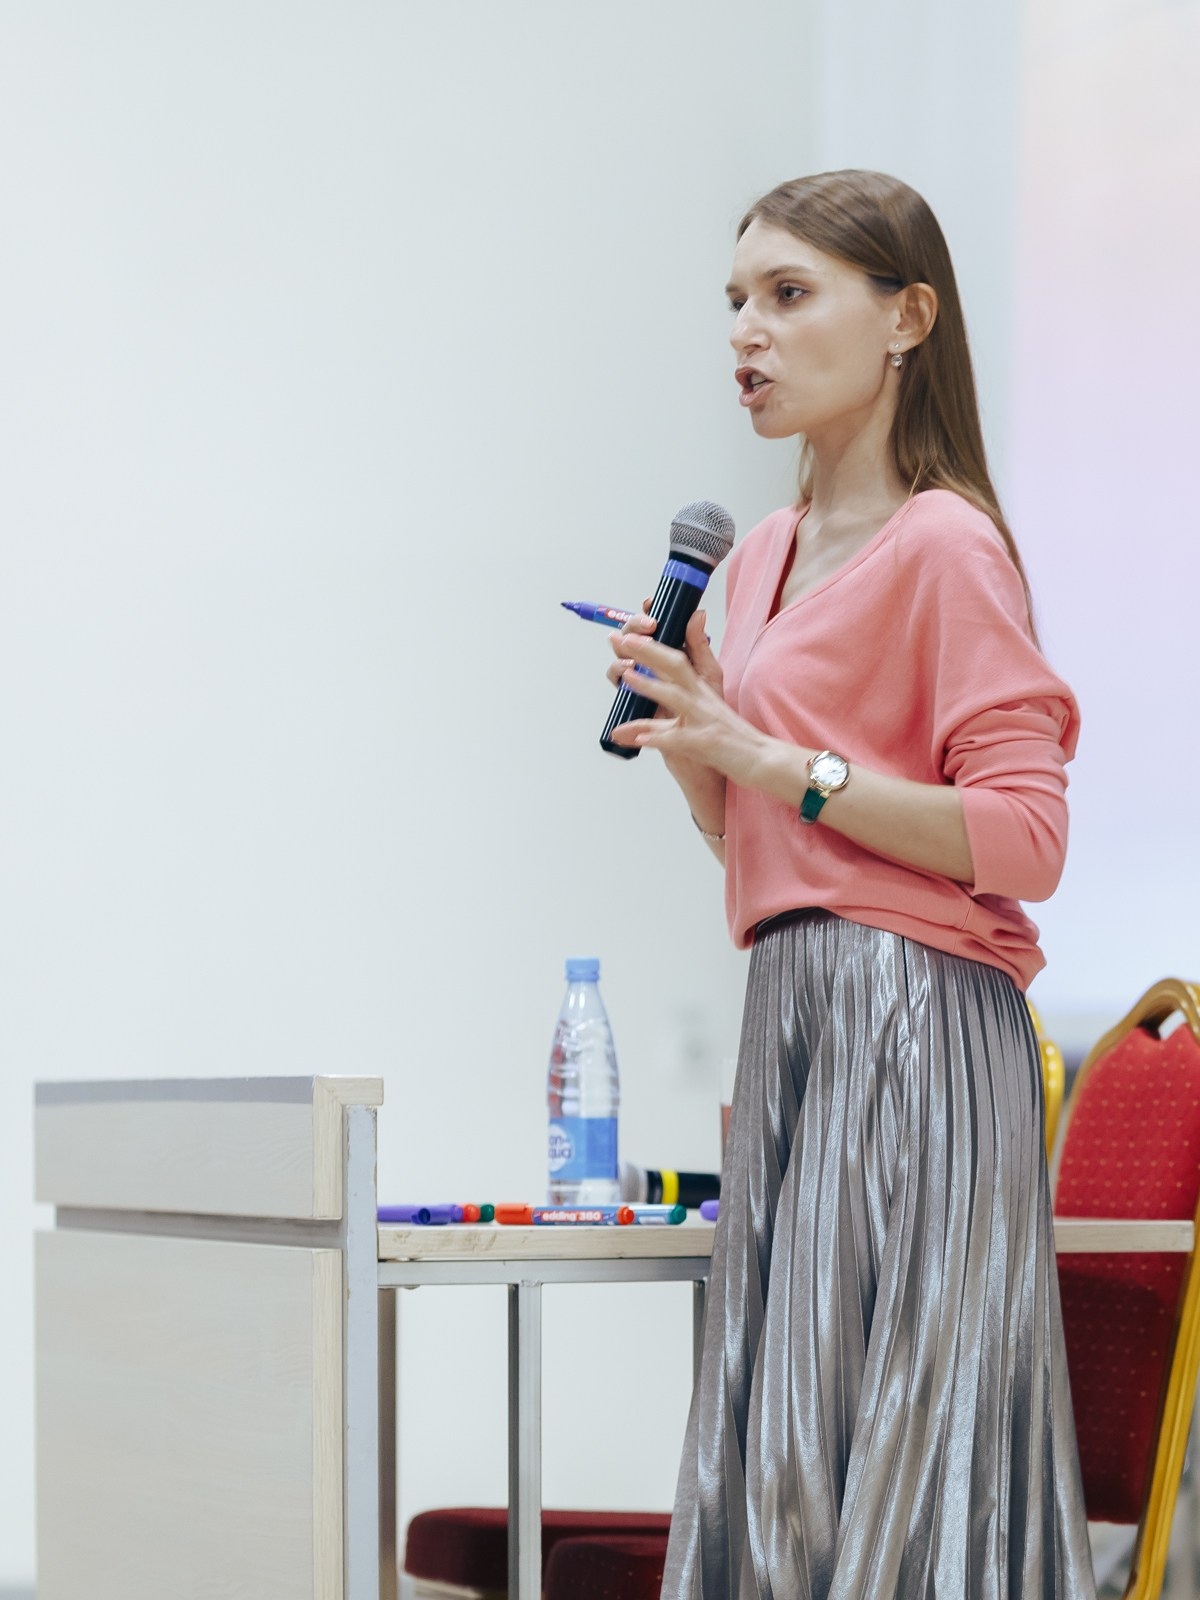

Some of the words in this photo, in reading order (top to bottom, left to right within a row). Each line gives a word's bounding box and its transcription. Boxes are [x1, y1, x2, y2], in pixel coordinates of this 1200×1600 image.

[607, 610, 633, 622] edd
[548, 1147, 571, 1162] qua
[541, 1211, 577, 1222] edding
[578, 1211, 600, 1222] 380
